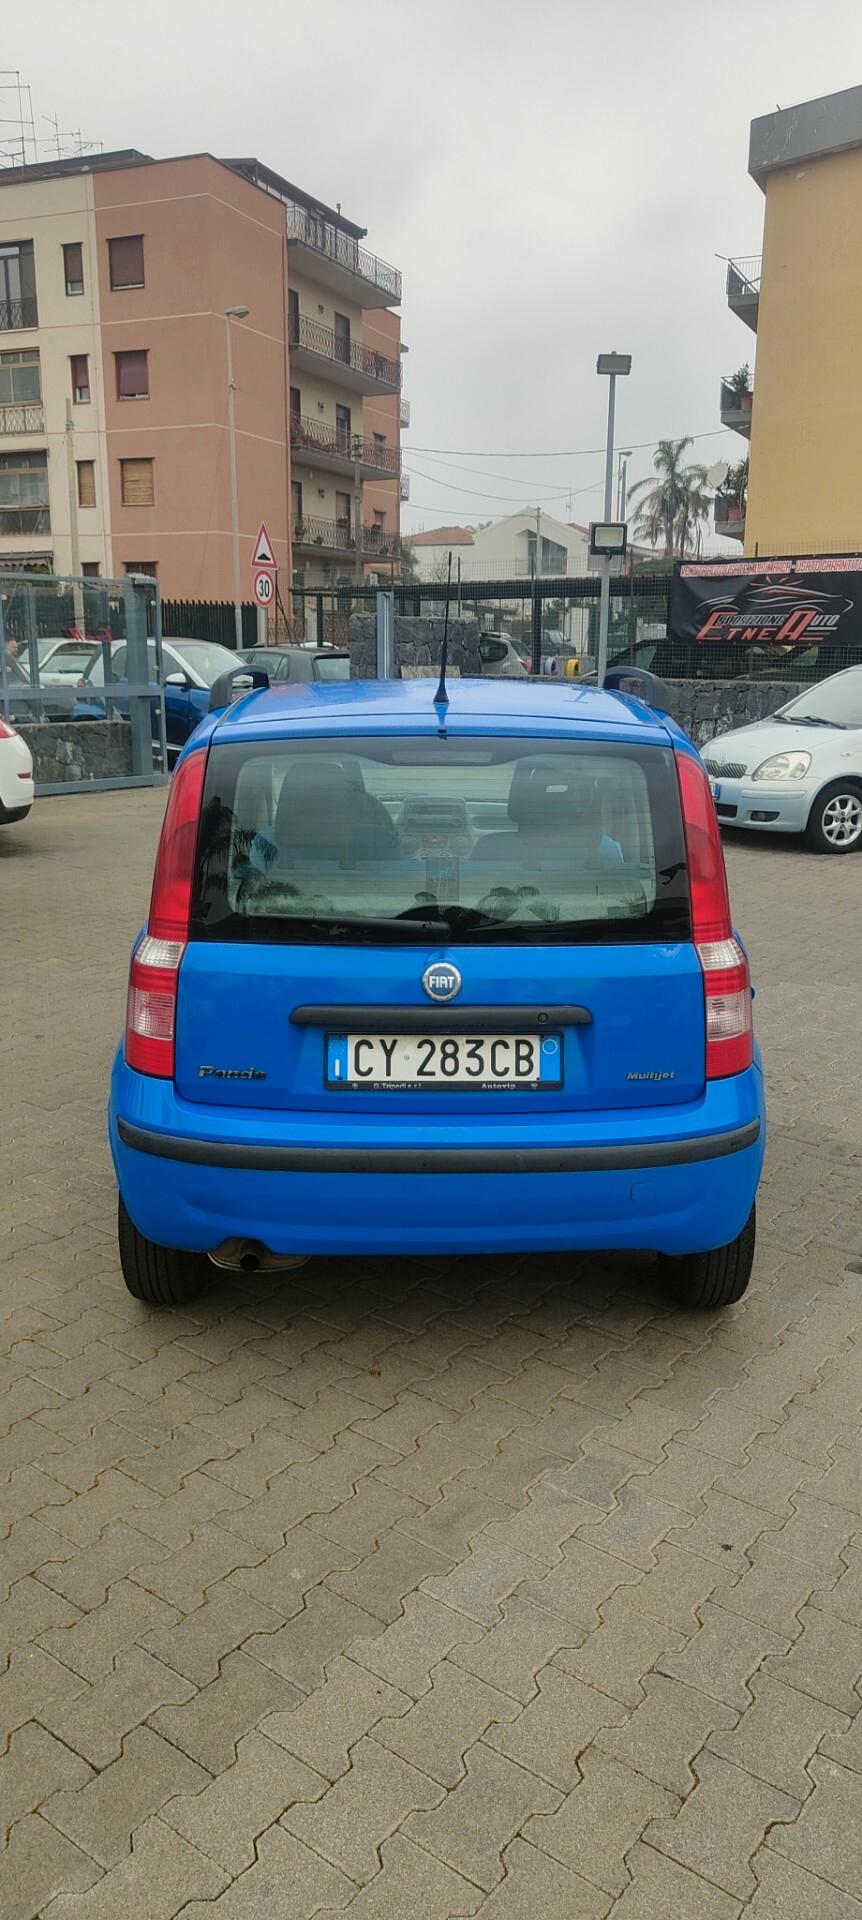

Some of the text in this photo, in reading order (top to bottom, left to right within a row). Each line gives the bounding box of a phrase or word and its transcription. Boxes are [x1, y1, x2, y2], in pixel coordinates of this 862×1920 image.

[259, 579, 270, 598] 30
[429, 975, 455, 989] FIAT
[353, 1038, 535, 1077] CY 283CB
[199, 1065, 266, 1081] Panda
[626, 1071, 675, 1081] Multijet
